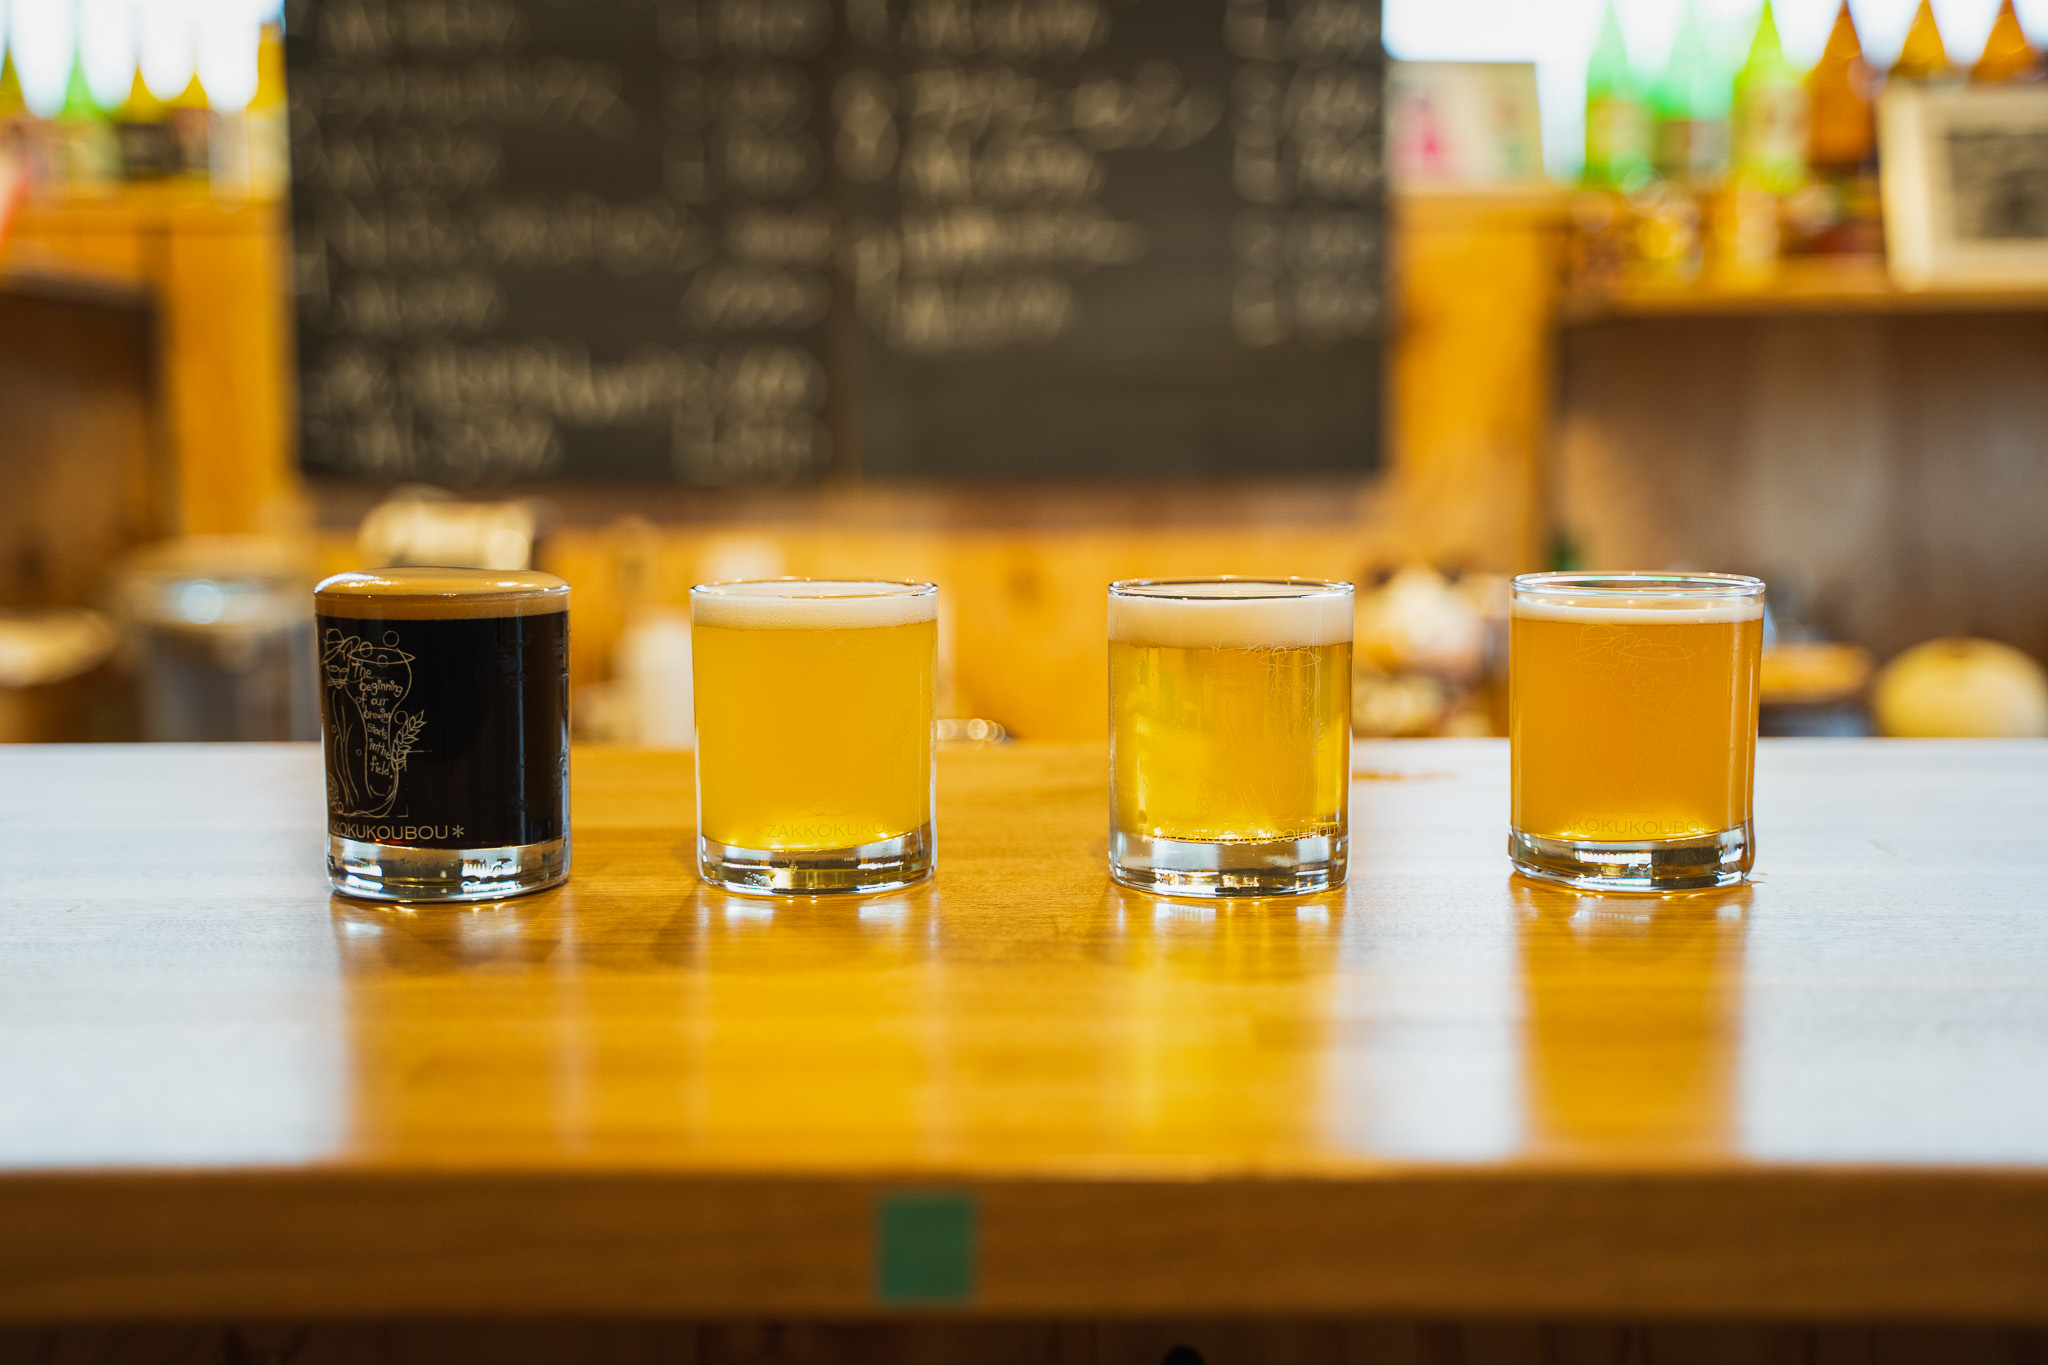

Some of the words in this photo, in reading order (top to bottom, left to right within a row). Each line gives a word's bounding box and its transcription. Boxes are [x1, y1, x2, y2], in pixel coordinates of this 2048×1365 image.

[359, 678, 404, 698] beginning
[355, 692, 367, 708] of
[370, 697, 389, 706] our
[363, 704, 391, 723] brewing
